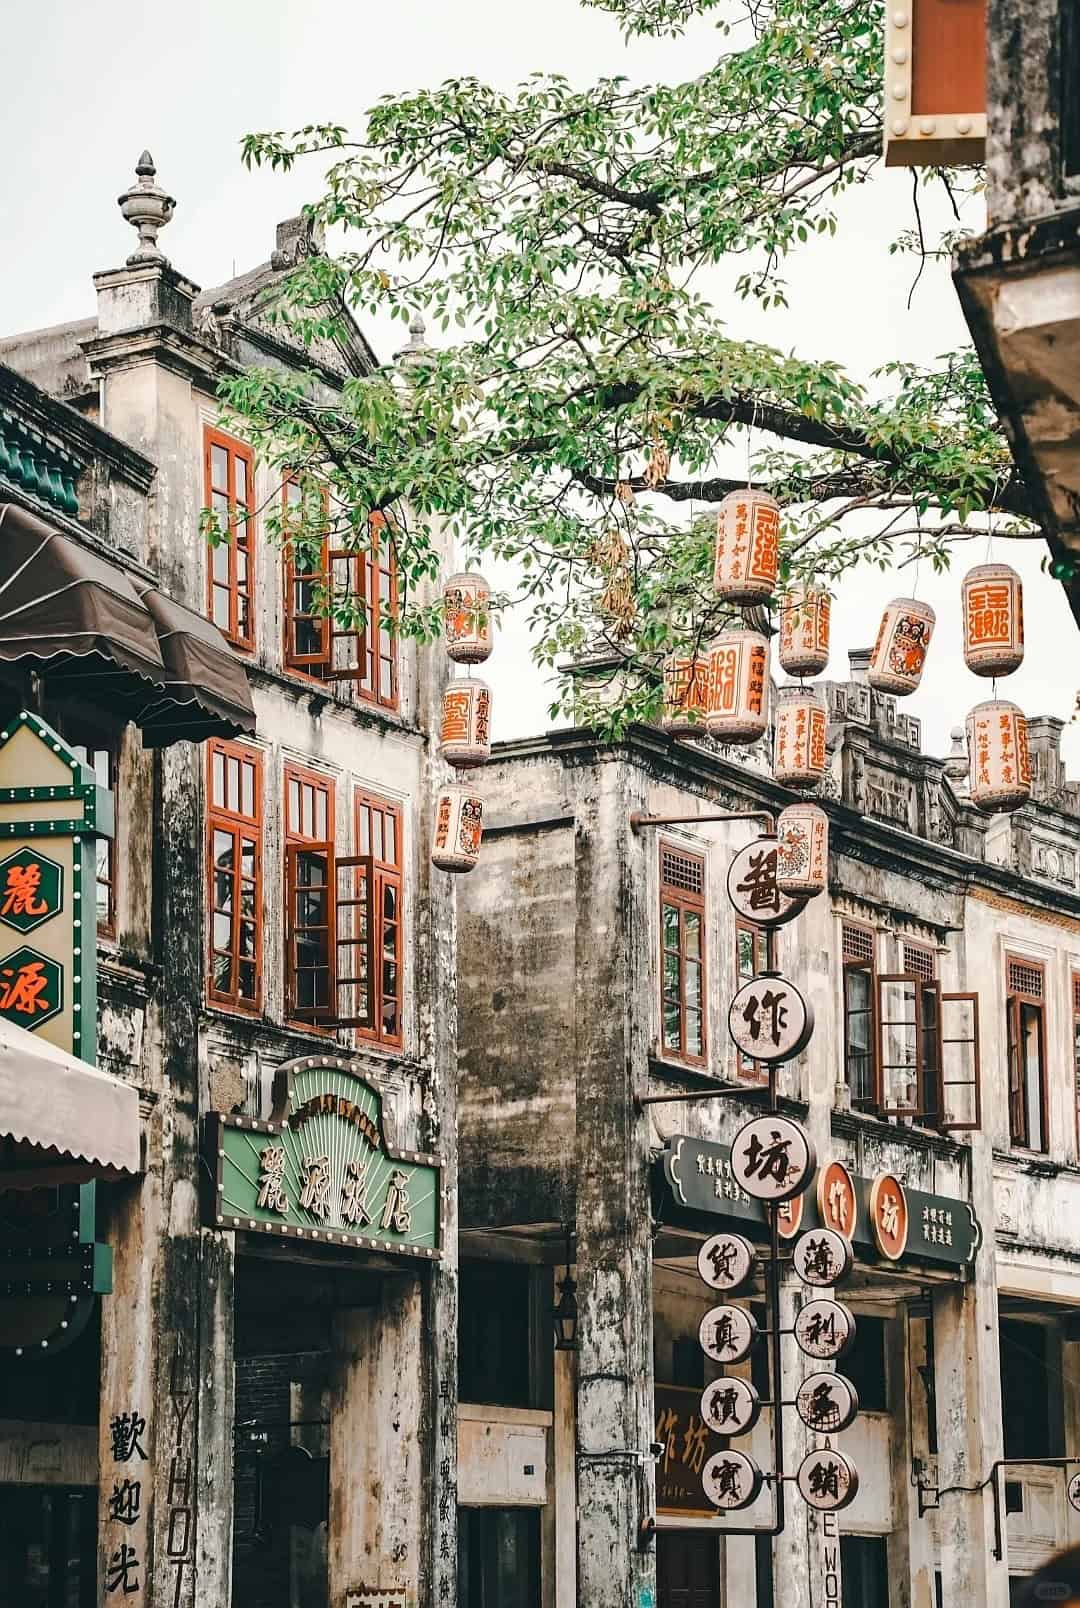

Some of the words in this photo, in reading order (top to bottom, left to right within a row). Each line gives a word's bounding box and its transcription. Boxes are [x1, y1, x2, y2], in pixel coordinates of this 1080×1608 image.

[731, 503, 748, 579] 萬事如意
[976, 719, 991, 785] 心想事成
[999, 714, 1014, 785] 萬事如意
